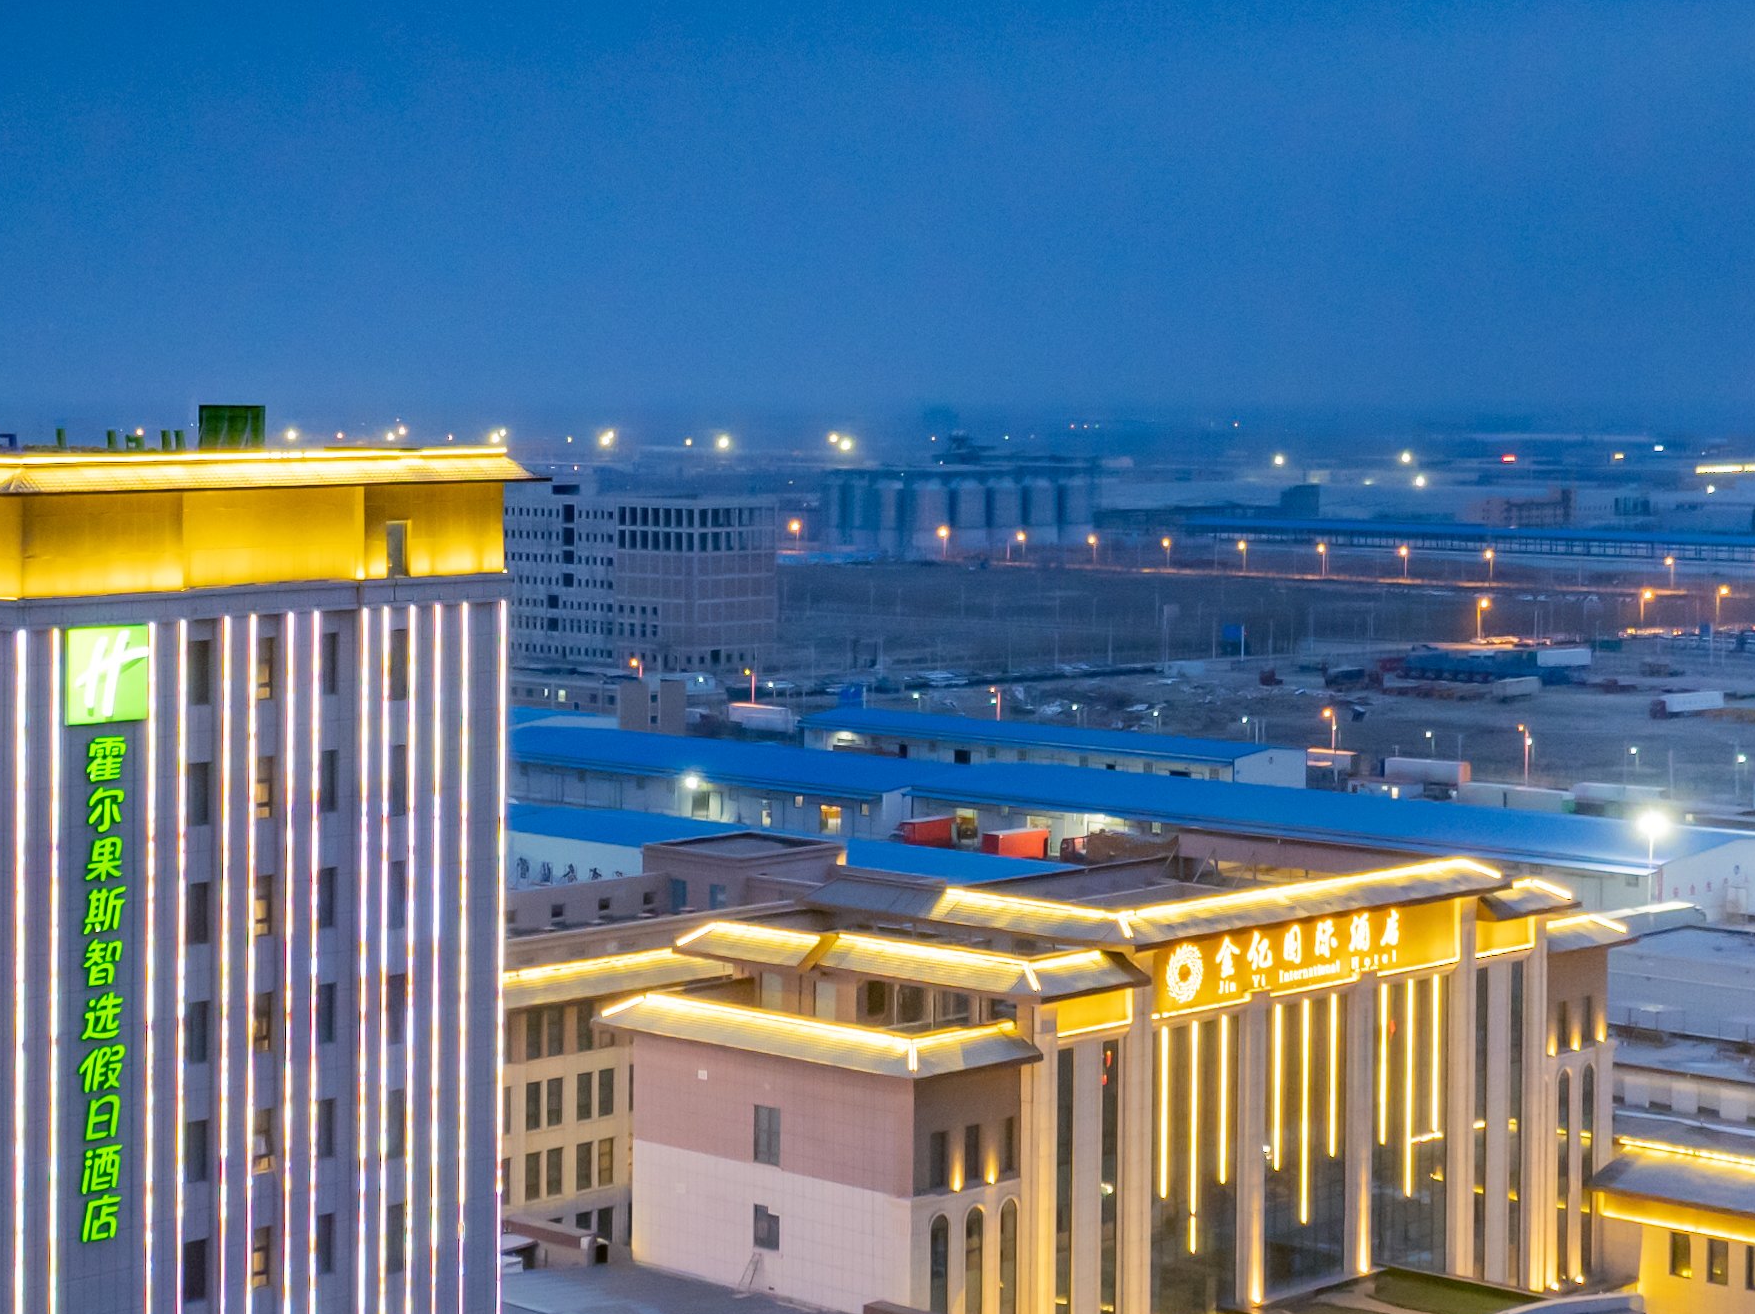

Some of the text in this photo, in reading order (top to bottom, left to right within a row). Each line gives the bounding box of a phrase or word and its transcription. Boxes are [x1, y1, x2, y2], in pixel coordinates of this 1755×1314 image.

[78, 735, 127, 1243] 霍尔果斯智选假日酒店
[1218, 949, 1397, 995] Jin Yi International Hotel
